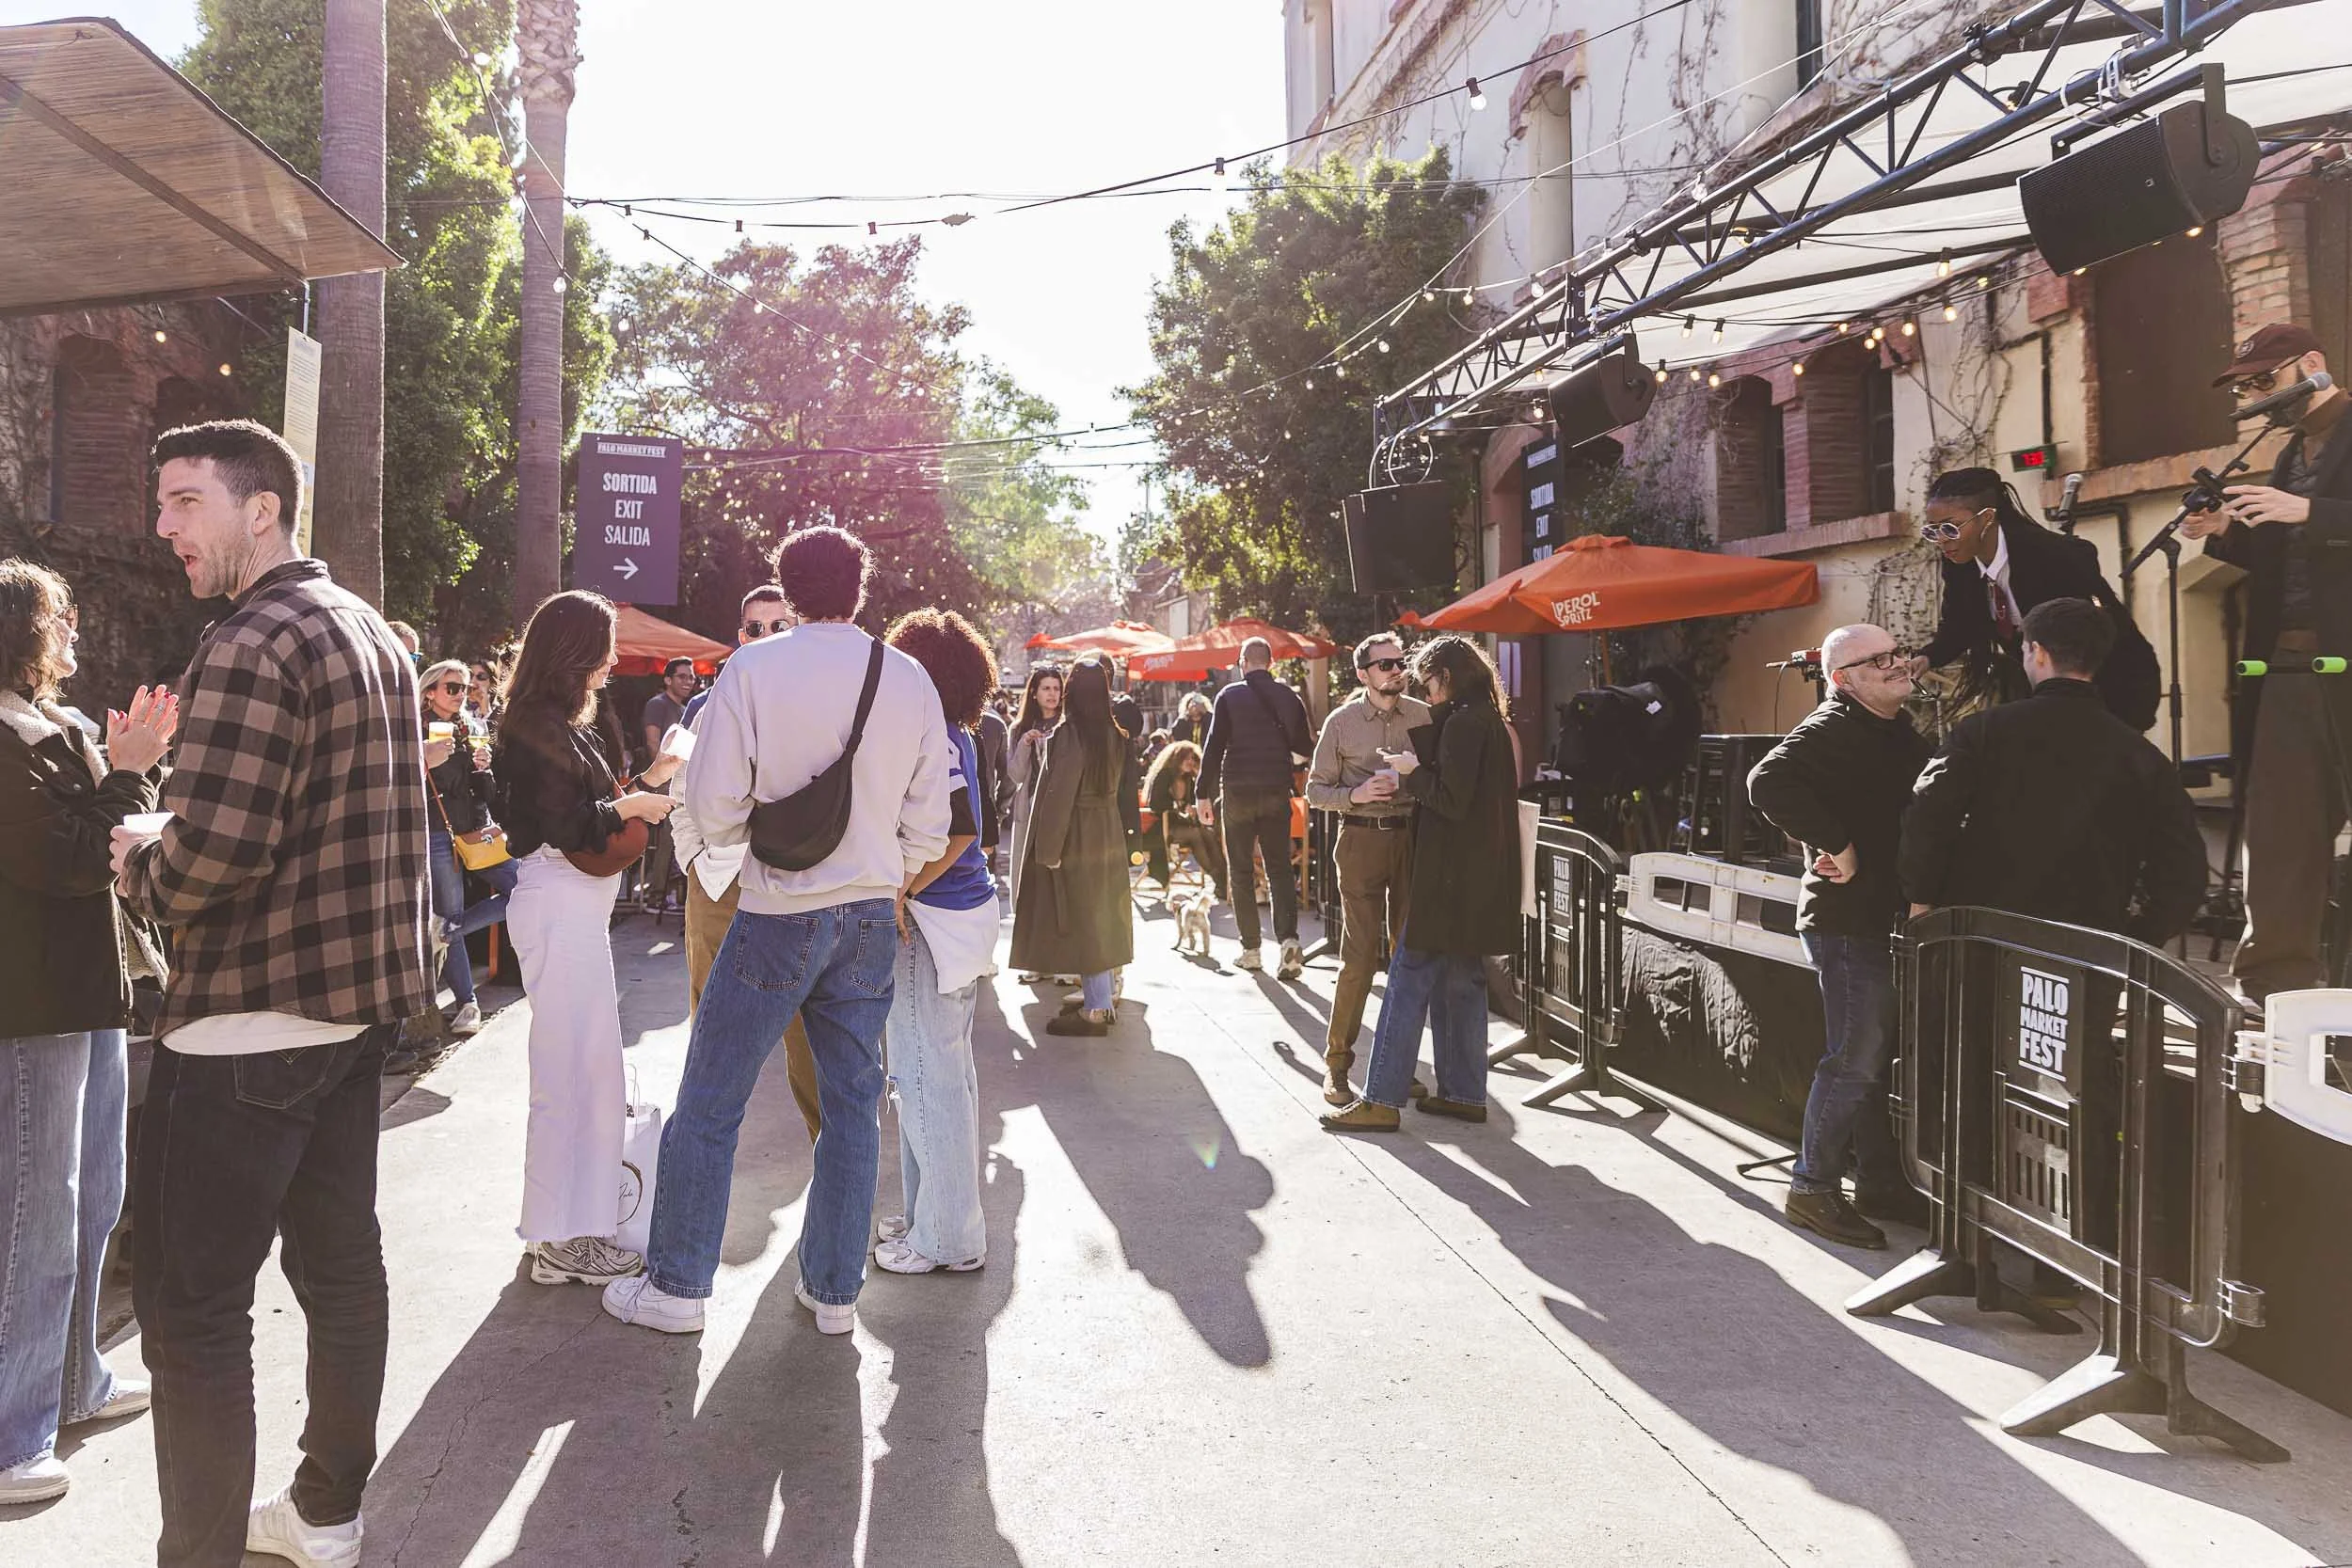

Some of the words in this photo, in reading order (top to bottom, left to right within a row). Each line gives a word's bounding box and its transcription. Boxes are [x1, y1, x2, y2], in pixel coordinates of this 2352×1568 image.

[602, 471, 658, 495] SORTIDA
[614, 499, 644, 520] EXIT
[604, 525, 651, 546] SALIDA
[1553, 890, 1570, 912] FEST
[2022, 972, 2069, 1016] PALO
[2020, 1006, 2069, 1040] MARKET
[2019, 1027, 2067, 1073] FEST
